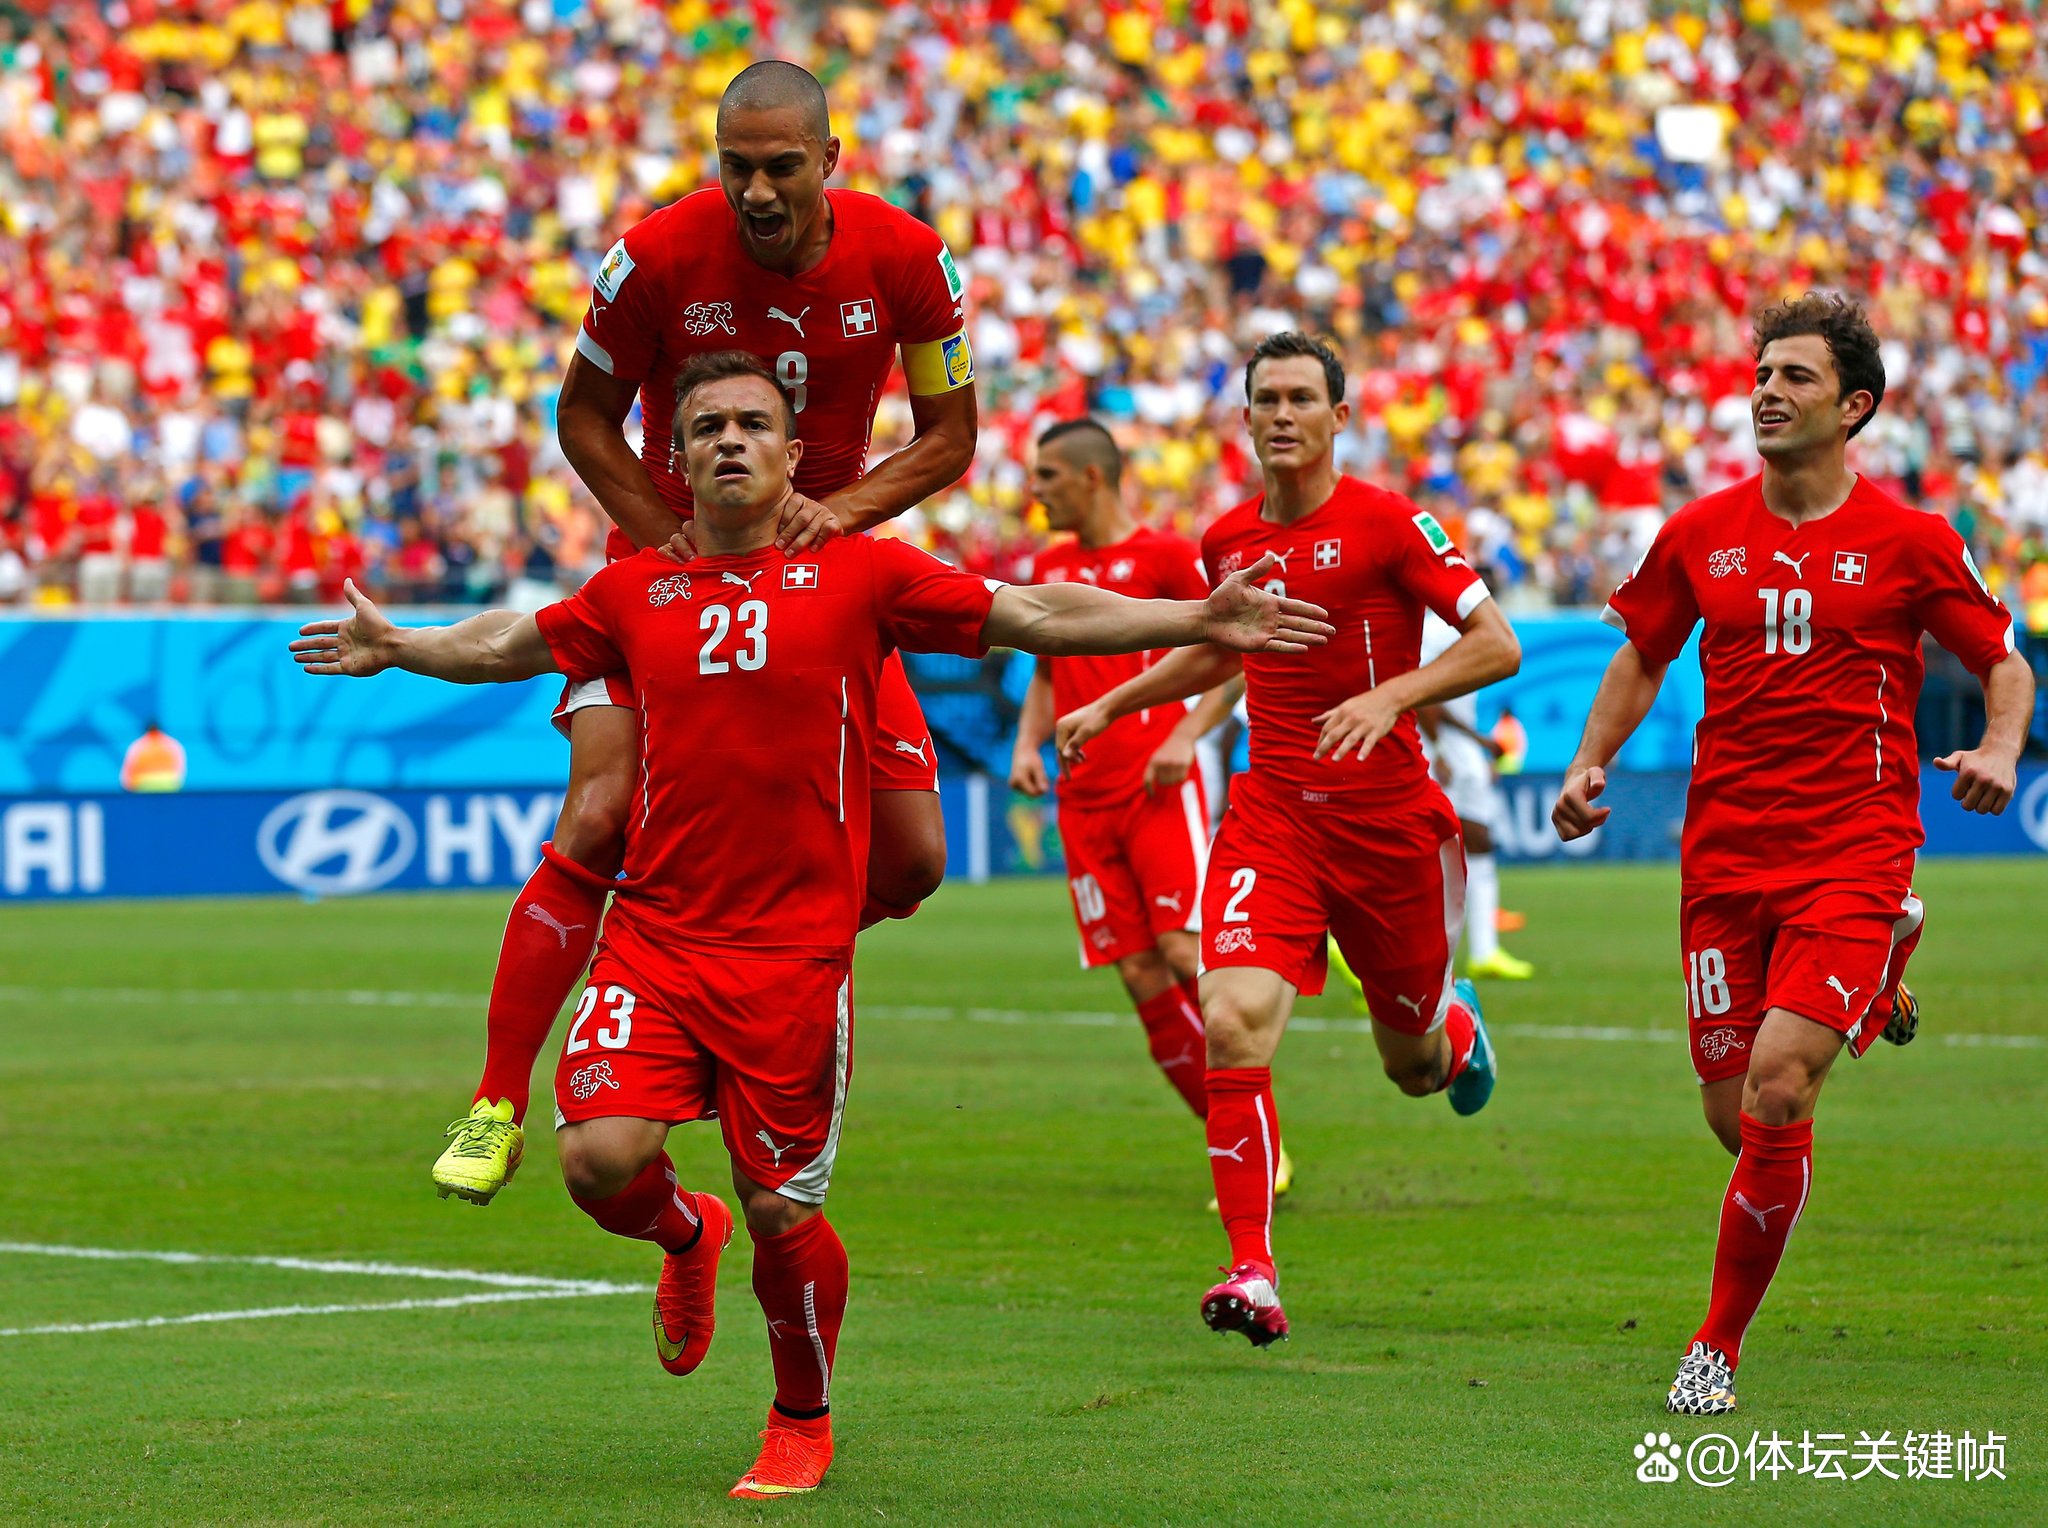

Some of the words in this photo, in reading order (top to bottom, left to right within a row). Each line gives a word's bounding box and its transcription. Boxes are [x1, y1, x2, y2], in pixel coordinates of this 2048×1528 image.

[776, 351, 808, 414] 8
[699, 599, 769, 675] 23
[1758, 588, 1813, 656] 18
[3, 800, 106, 895] AI
[424, 793, 566, 885] HY
[1071, 873, 1107, 926] 10
[1223, 867, 1257, 923] 2
[1689, 947, 1732, 1018] 18
[566, 985, 637, 1056] 23
